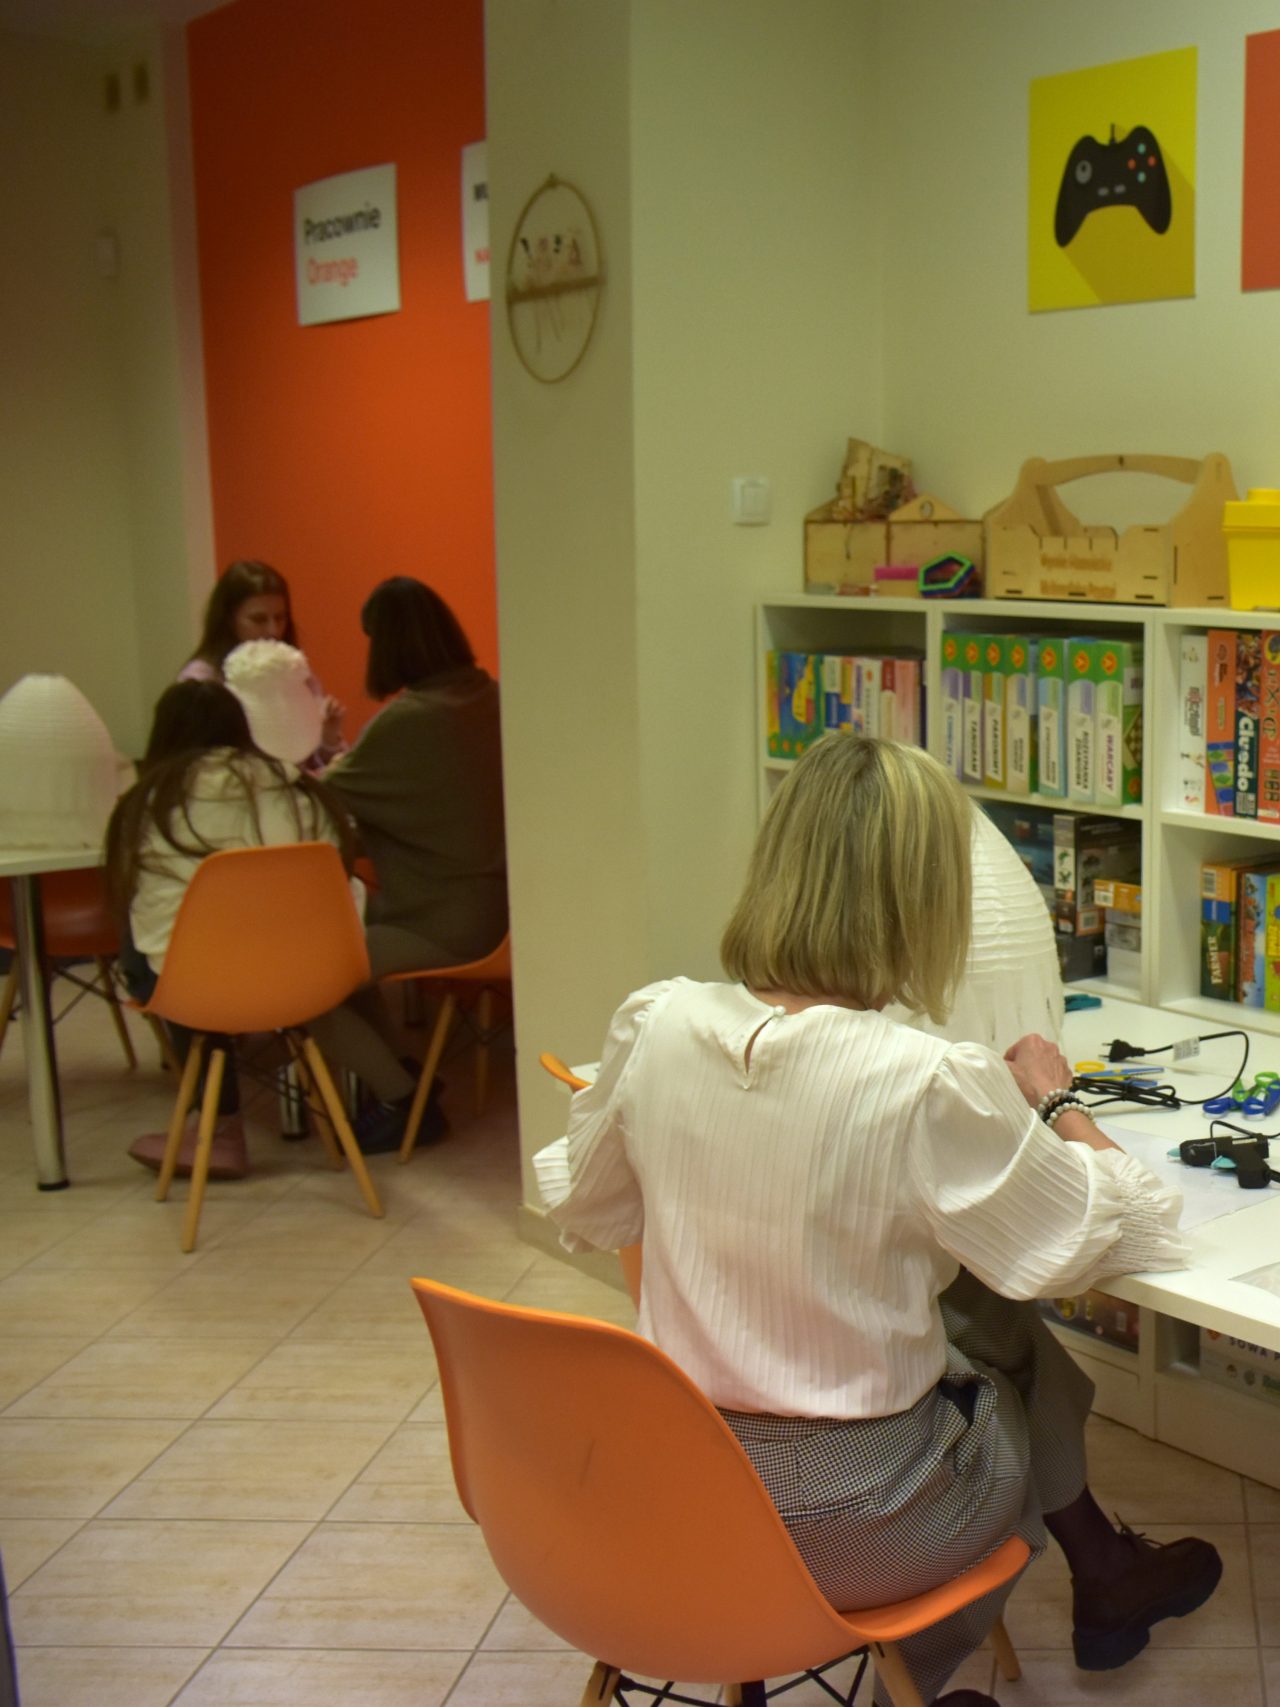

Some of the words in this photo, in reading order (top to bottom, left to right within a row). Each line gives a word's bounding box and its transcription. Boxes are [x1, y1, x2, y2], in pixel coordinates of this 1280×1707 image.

[304, 201, 381, 245] Pracownie
[306, 256, 360, 288] Orange
[970, 720, 978, 773] TANGRAM
[1105, 733, 1115, 792] WARCABY
[1237, 716, 1256, 791] Cluedo
[1207, 936, 1223, 984] FARMER
[1229, 1337, 1268, 1357] SOWA
